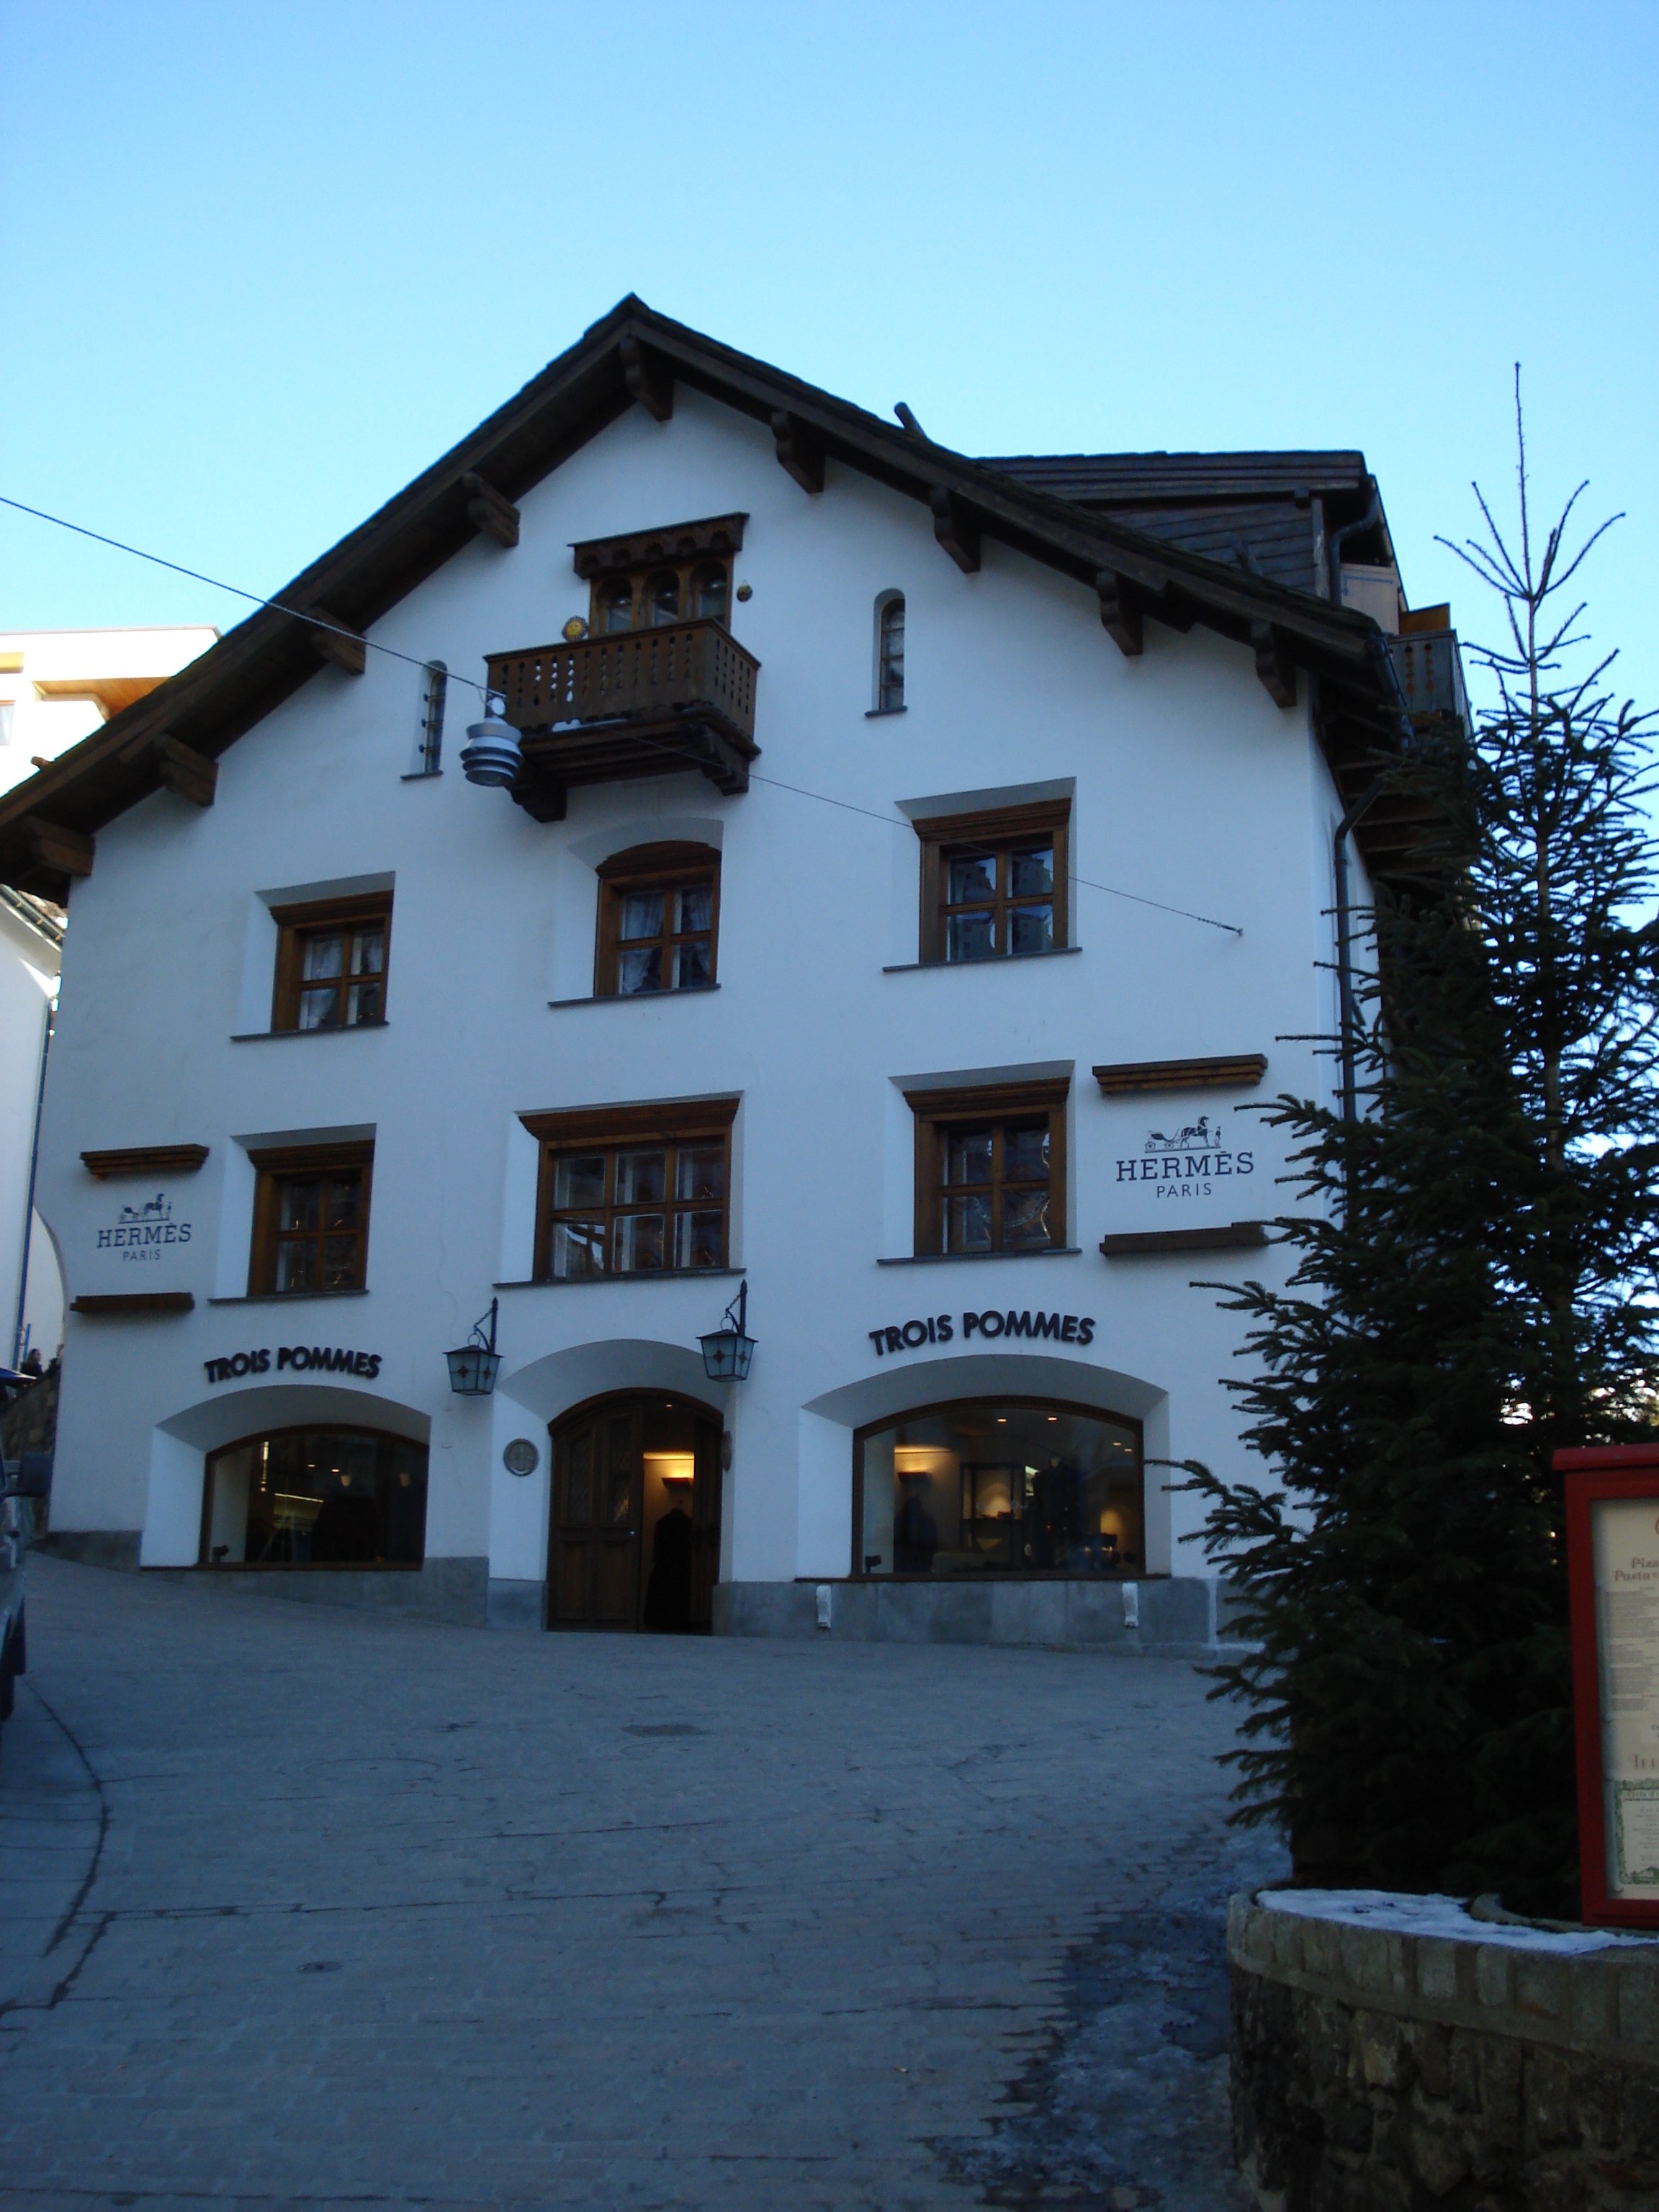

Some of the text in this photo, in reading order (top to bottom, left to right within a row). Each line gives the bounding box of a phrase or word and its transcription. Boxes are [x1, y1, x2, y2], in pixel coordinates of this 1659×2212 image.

[1156, 1182, 1212, 1198] PARIS
[122, 1249, 161, 1262] PARIS
[869, 1310, 1096, 1356] TROIS POMMES
[204, 1346, 382, 1383] TROIS POMMES
